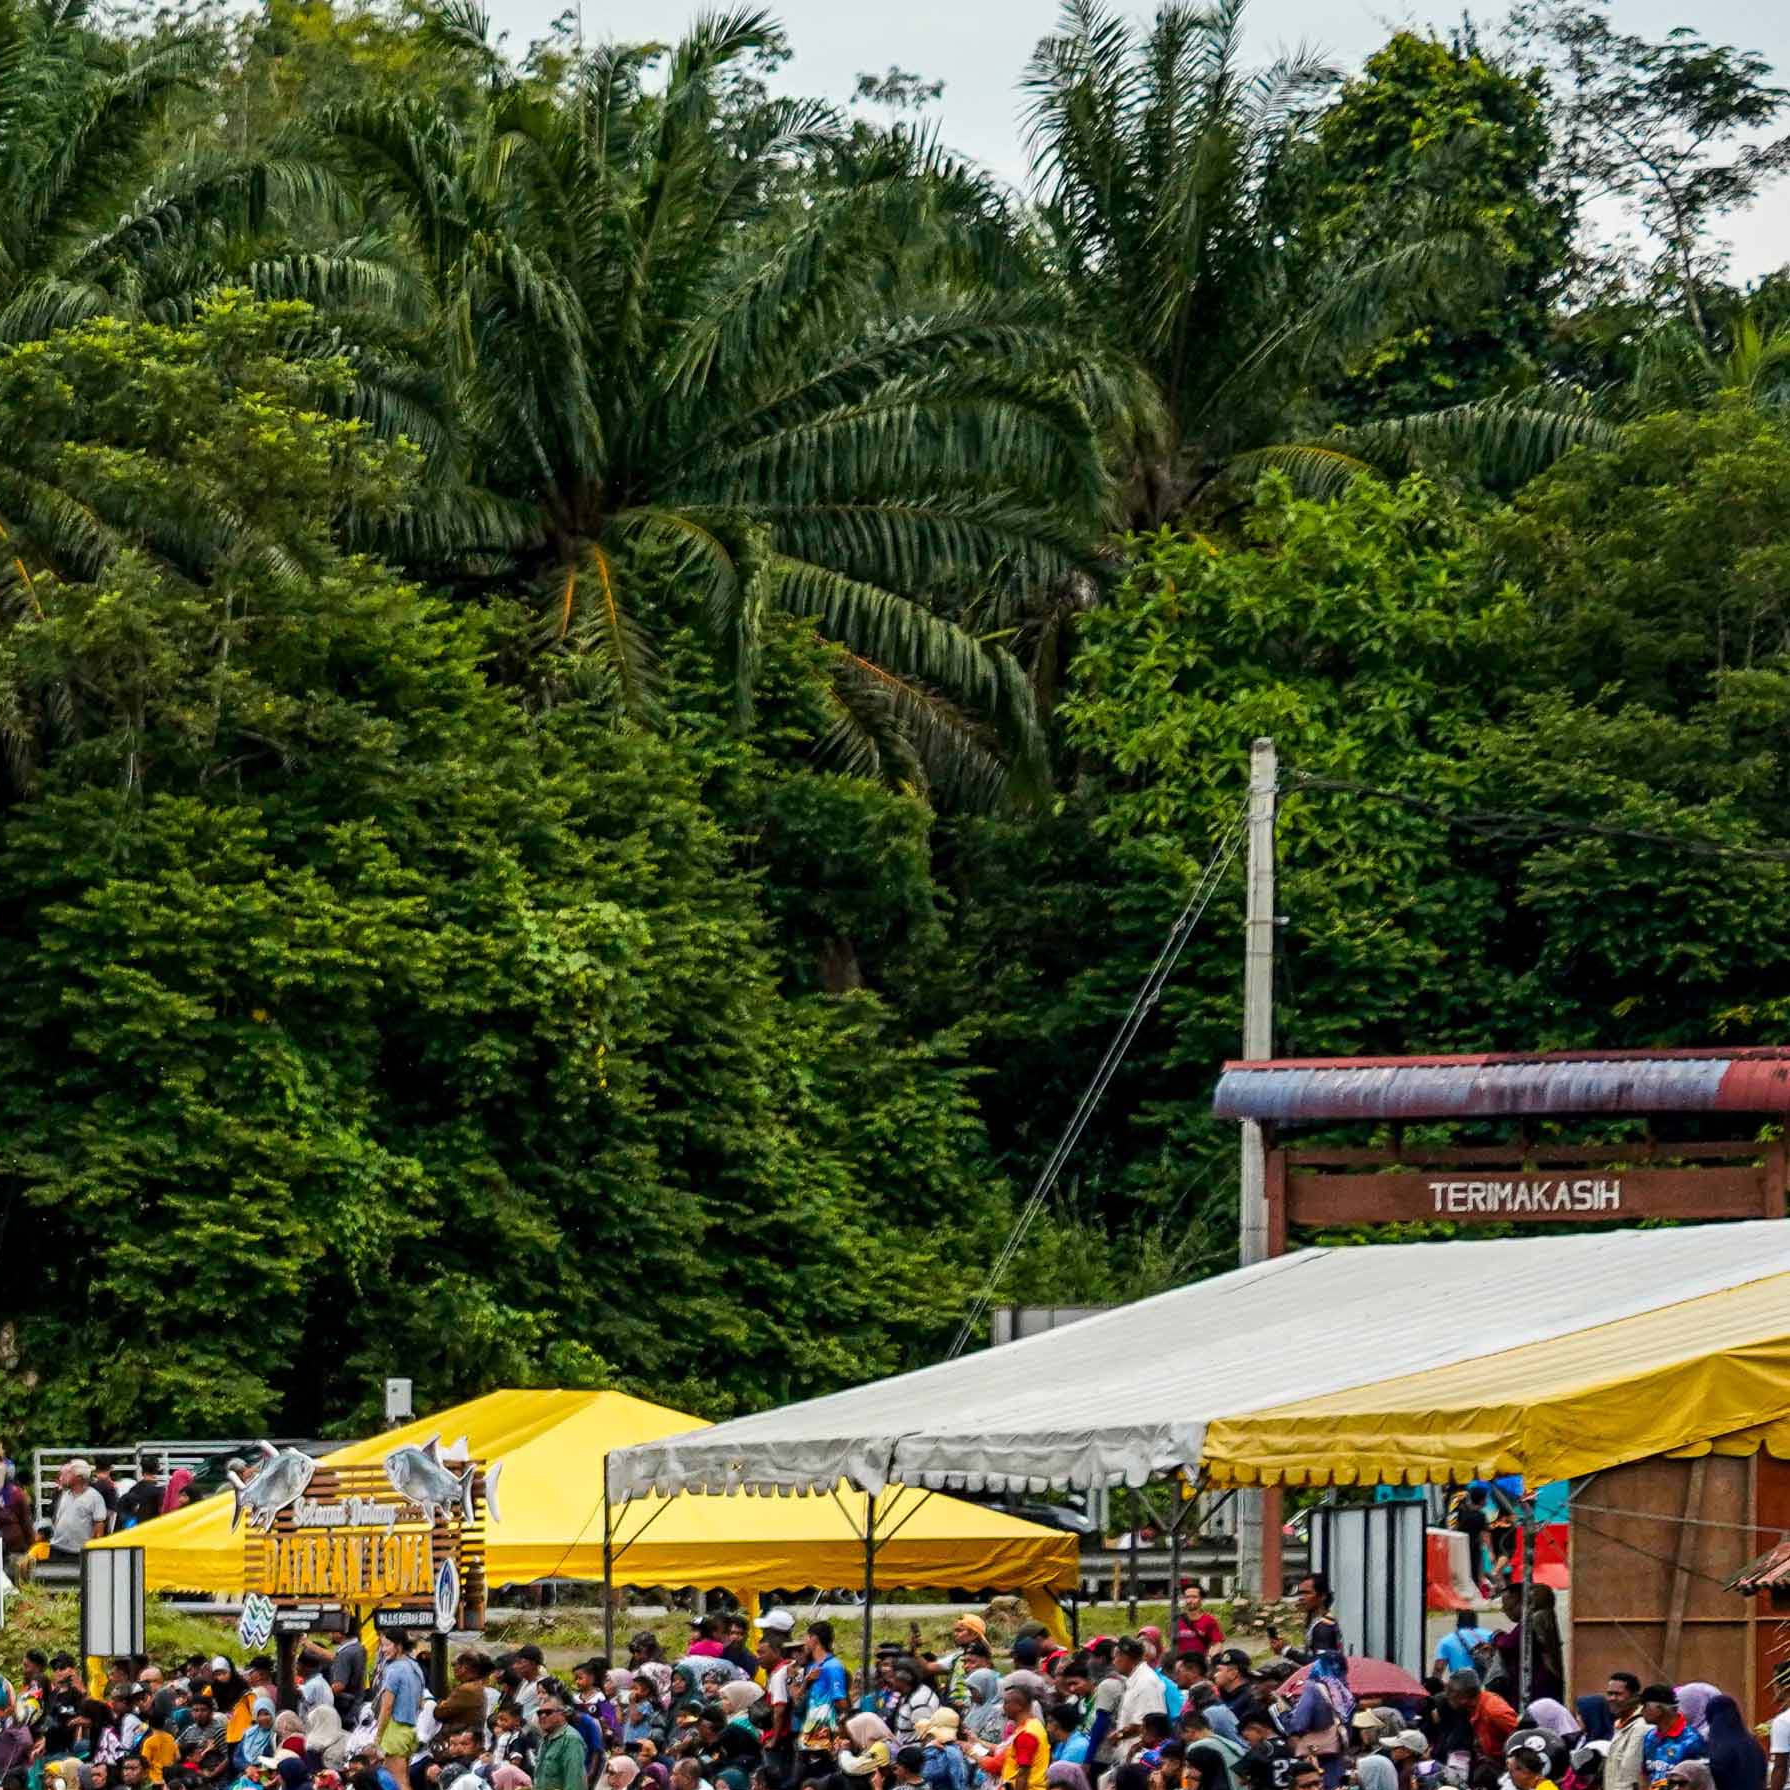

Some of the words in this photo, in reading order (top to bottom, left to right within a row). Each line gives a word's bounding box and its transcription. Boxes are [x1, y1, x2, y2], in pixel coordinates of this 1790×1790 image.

[1429, 1179, 1621, 1213] TERIMAKASIH
[263, 1535, 363, 1594] DATARAN
[370, 1534, 435, 1594] LOMA
